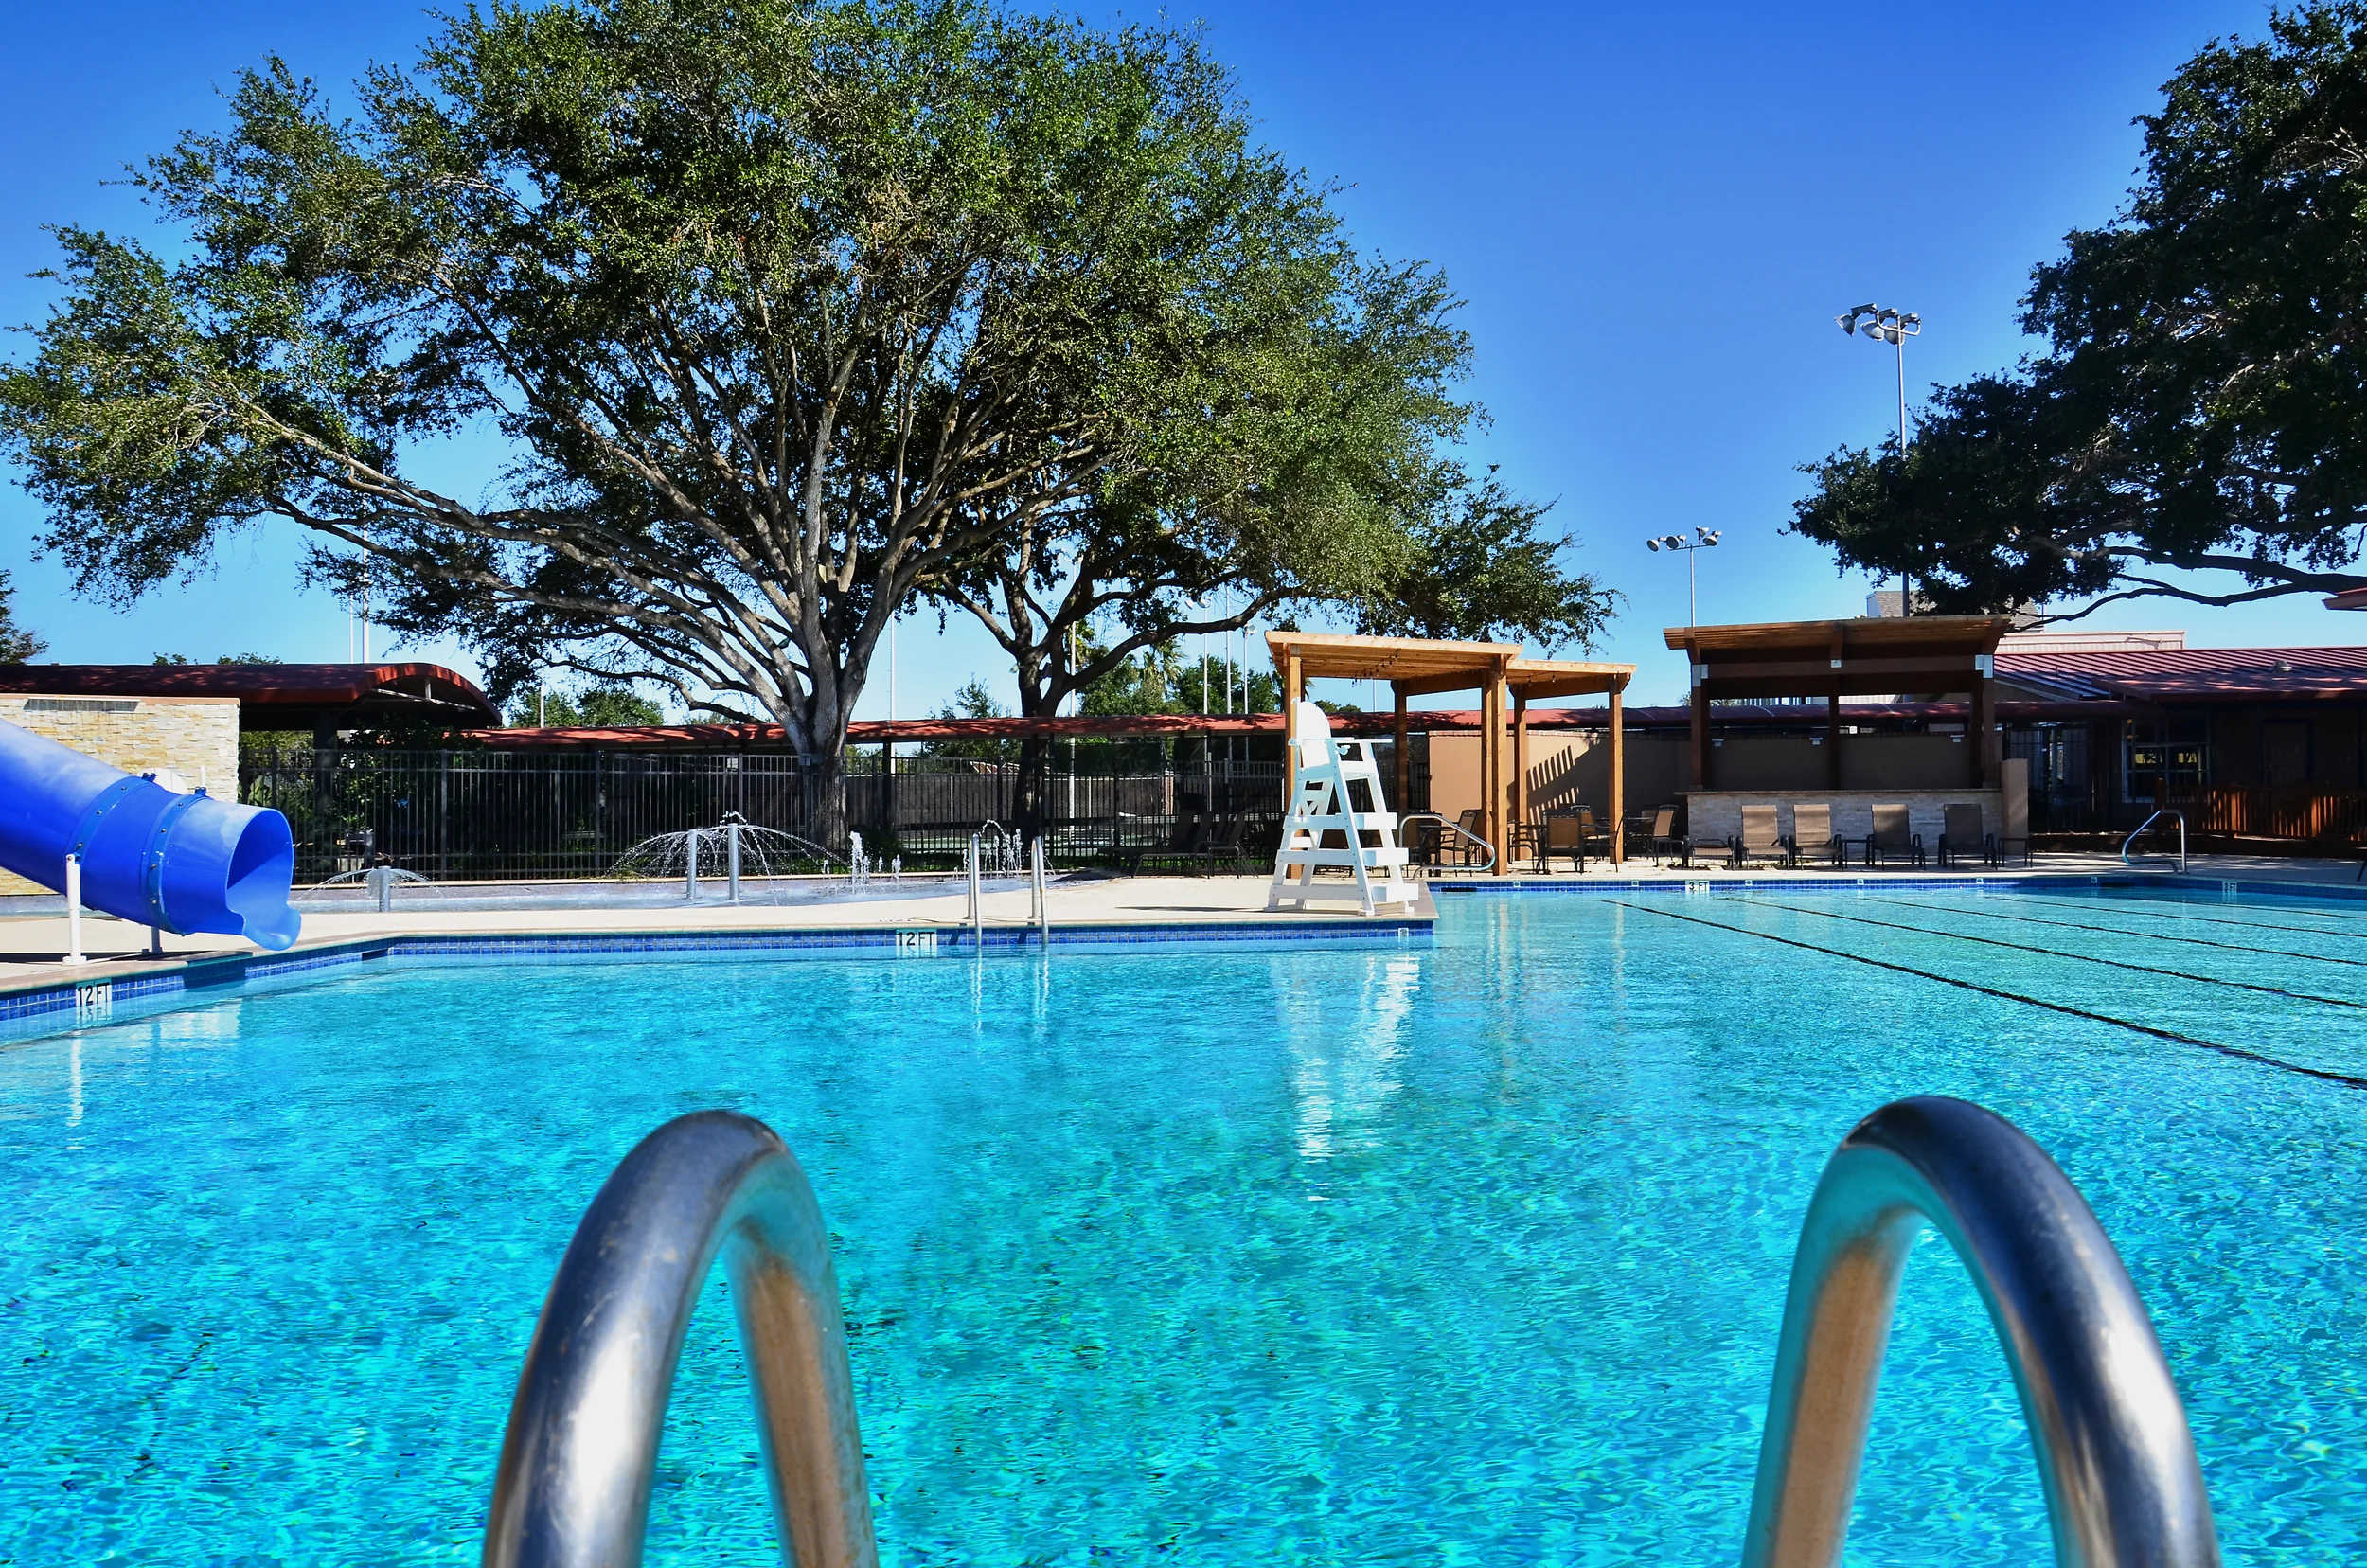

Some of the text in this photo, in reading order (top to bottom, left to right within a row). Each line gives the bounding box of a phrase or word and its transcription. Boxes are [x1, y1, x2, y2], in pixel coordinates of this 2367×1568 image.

[1688, 882, 1709, 892] 3 FT
[897, 932, 935, 946] 12 FT
[78, 982, 110, 1007] 12 FT
